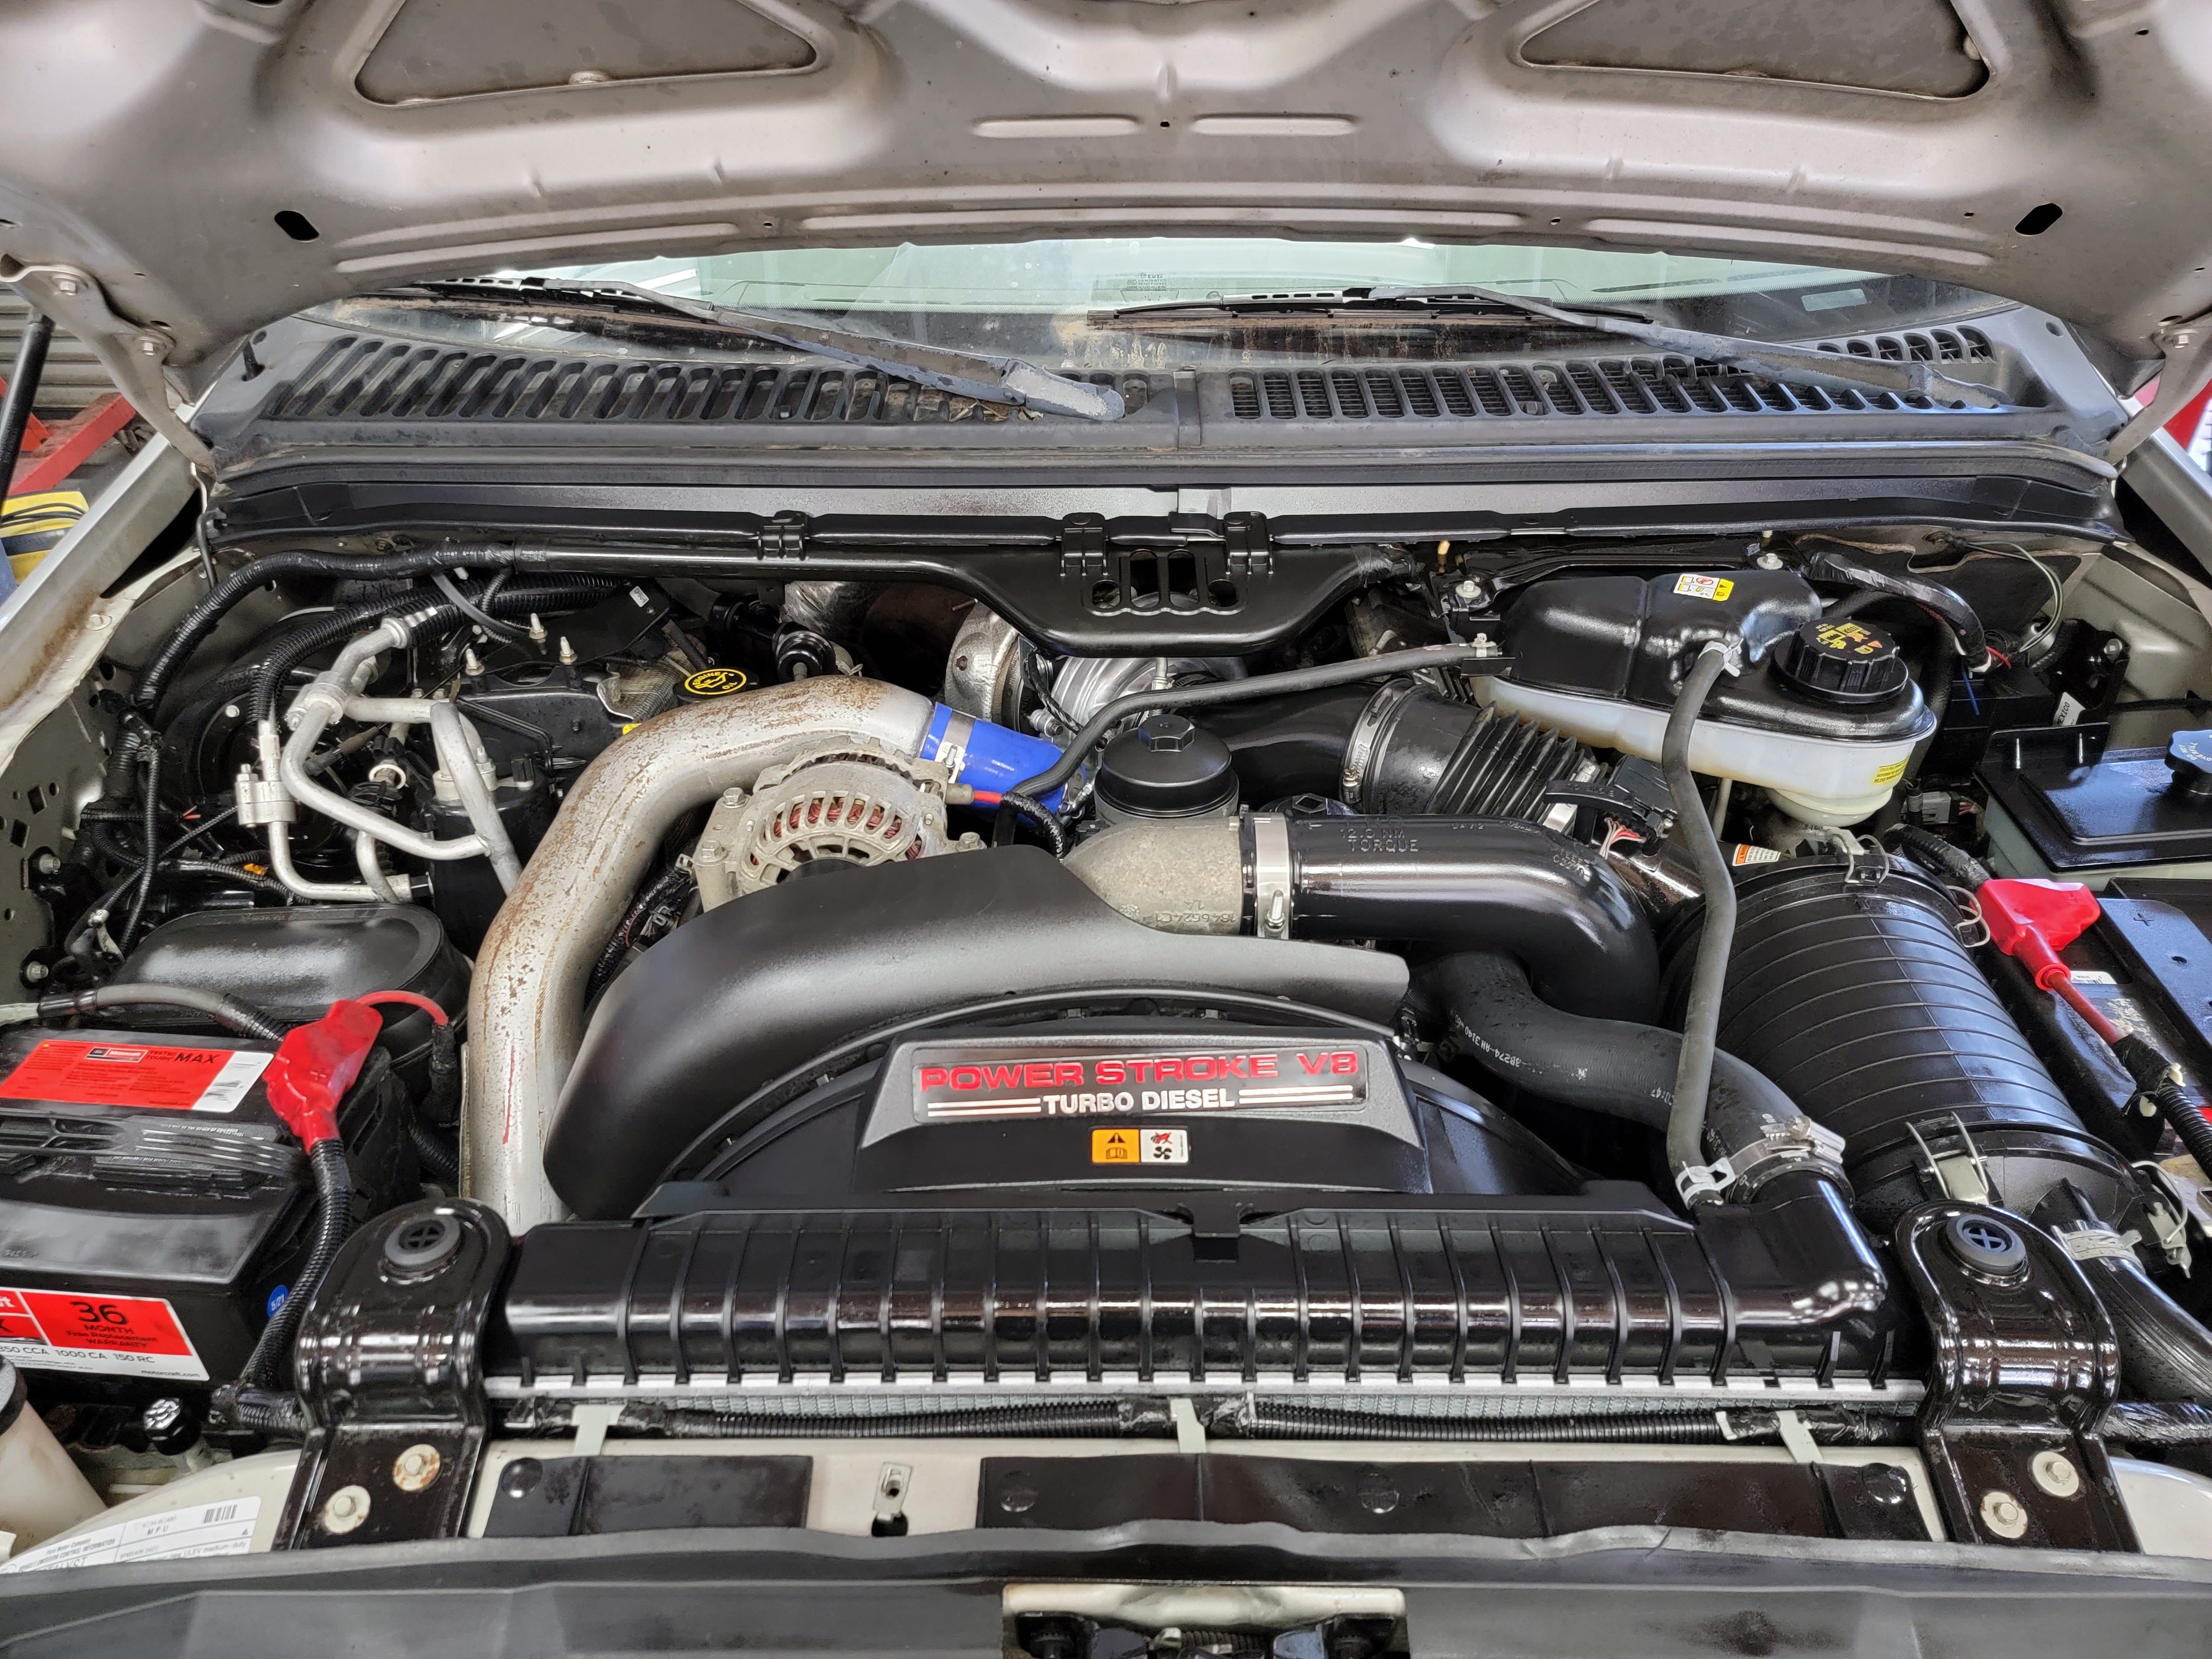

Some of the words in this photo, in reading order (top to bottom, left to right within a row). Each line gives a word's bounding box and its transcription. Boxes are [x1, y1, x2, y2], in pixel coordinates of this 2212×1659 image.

[692, 671, 721, 686] ENGINE
[722, 681, 738, 690] OIL
[2178, 744, 2188, 753] NOT
[1347, 838, 1419, 853] TORQUE
[174, 1052, 219, 1063] MAX
[920, 1062, 1082, 1091] POWER
[1095, 1053, 1278, 1085] STROKE
[1296, 1050, 1358, 1076] V8
[1042, 1092, 1134, 1115] TURBO
[1141, 1088, 1235, 1111] DIESEL
[70, 1301, 128, 1325] 36
[84, 1324, 134, 1334] MONTH
[87, 1338, 148, 1348] WARRANTY
[23, 1347, 50, 1355] CCA
[55, 1349, 86, 1358] 1000
[113, 1353, 135, 1361] 150
[60, 1550, 81, 1559] CONTROL
[83, 1538, 116, 1552] INFORMATION
